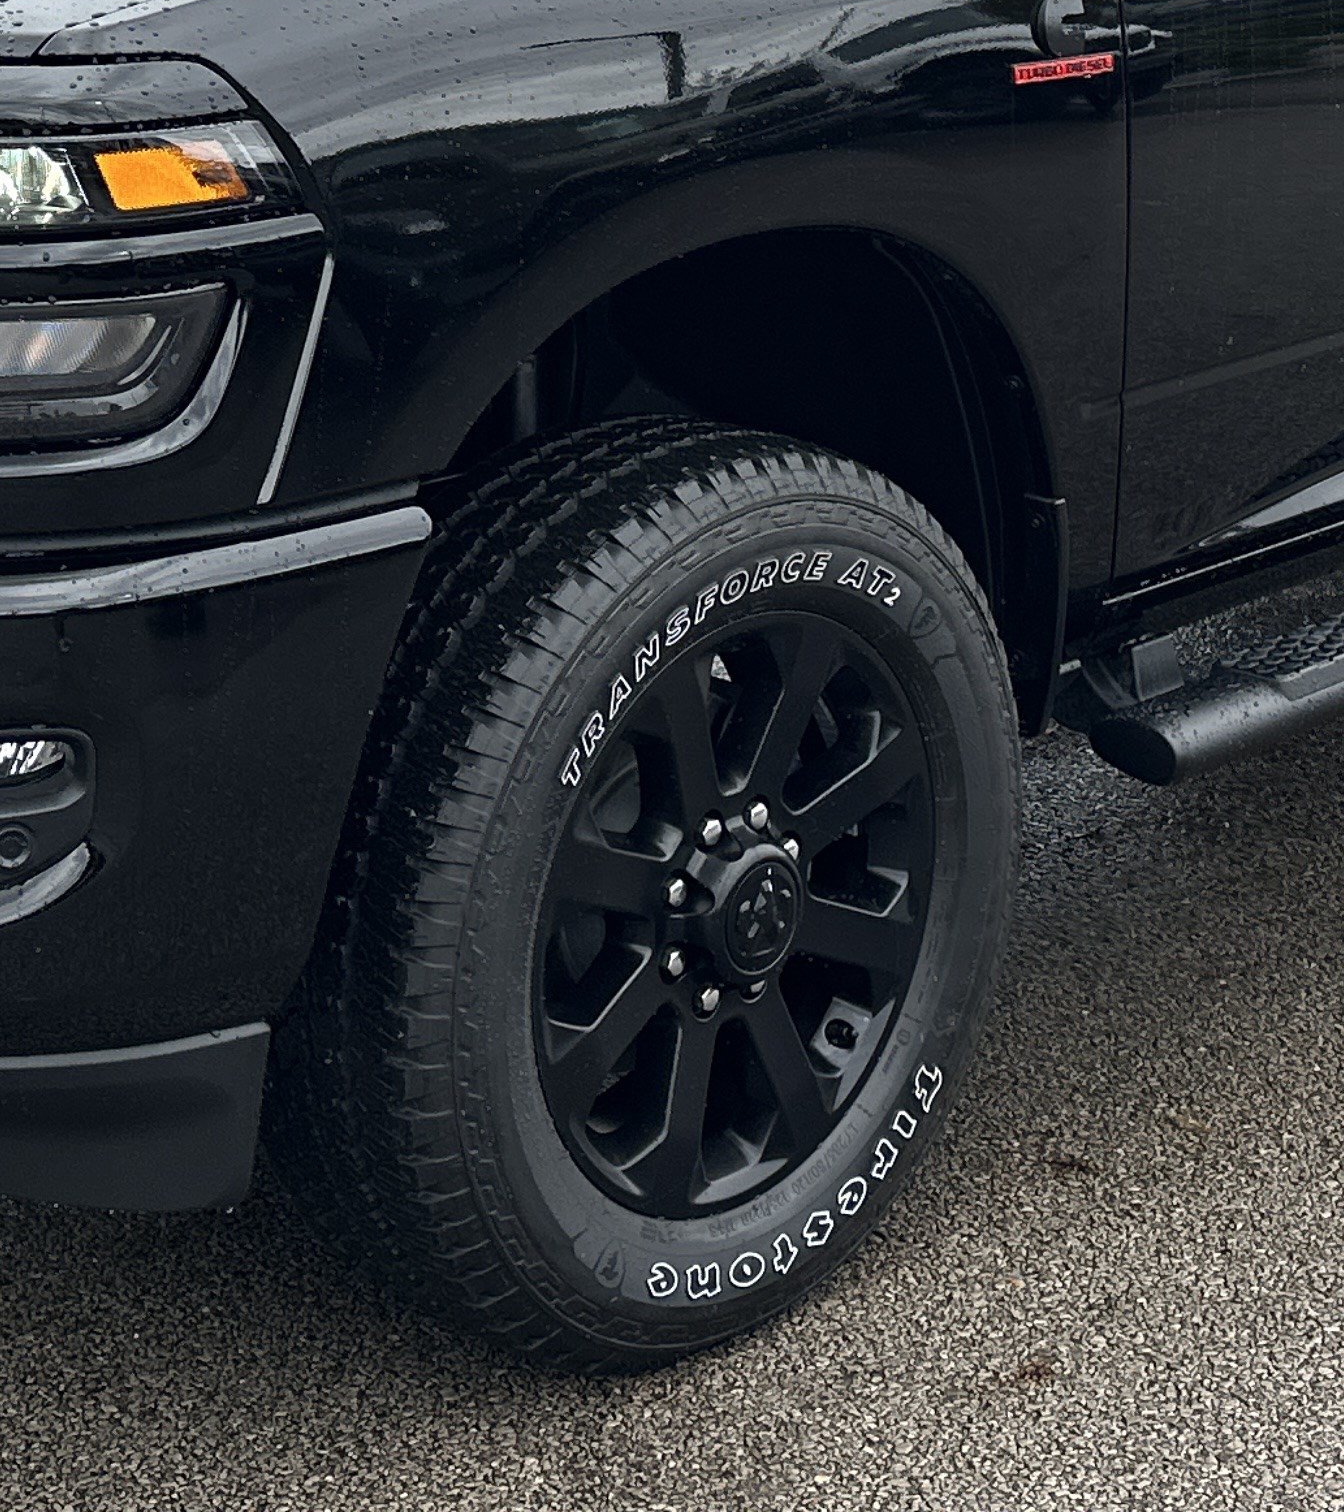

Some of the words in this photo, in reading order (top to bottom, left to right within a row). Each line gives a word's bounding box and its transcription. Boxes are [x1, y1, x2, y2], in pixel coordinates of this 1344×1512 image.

[1017, 65, 1064, 80] TURBO
[1065, 56, 1114, 75] DIESEL
[561, 551, 832, 787] TRANSFORCE
[647, 1064, 943, 1299] Firestone
